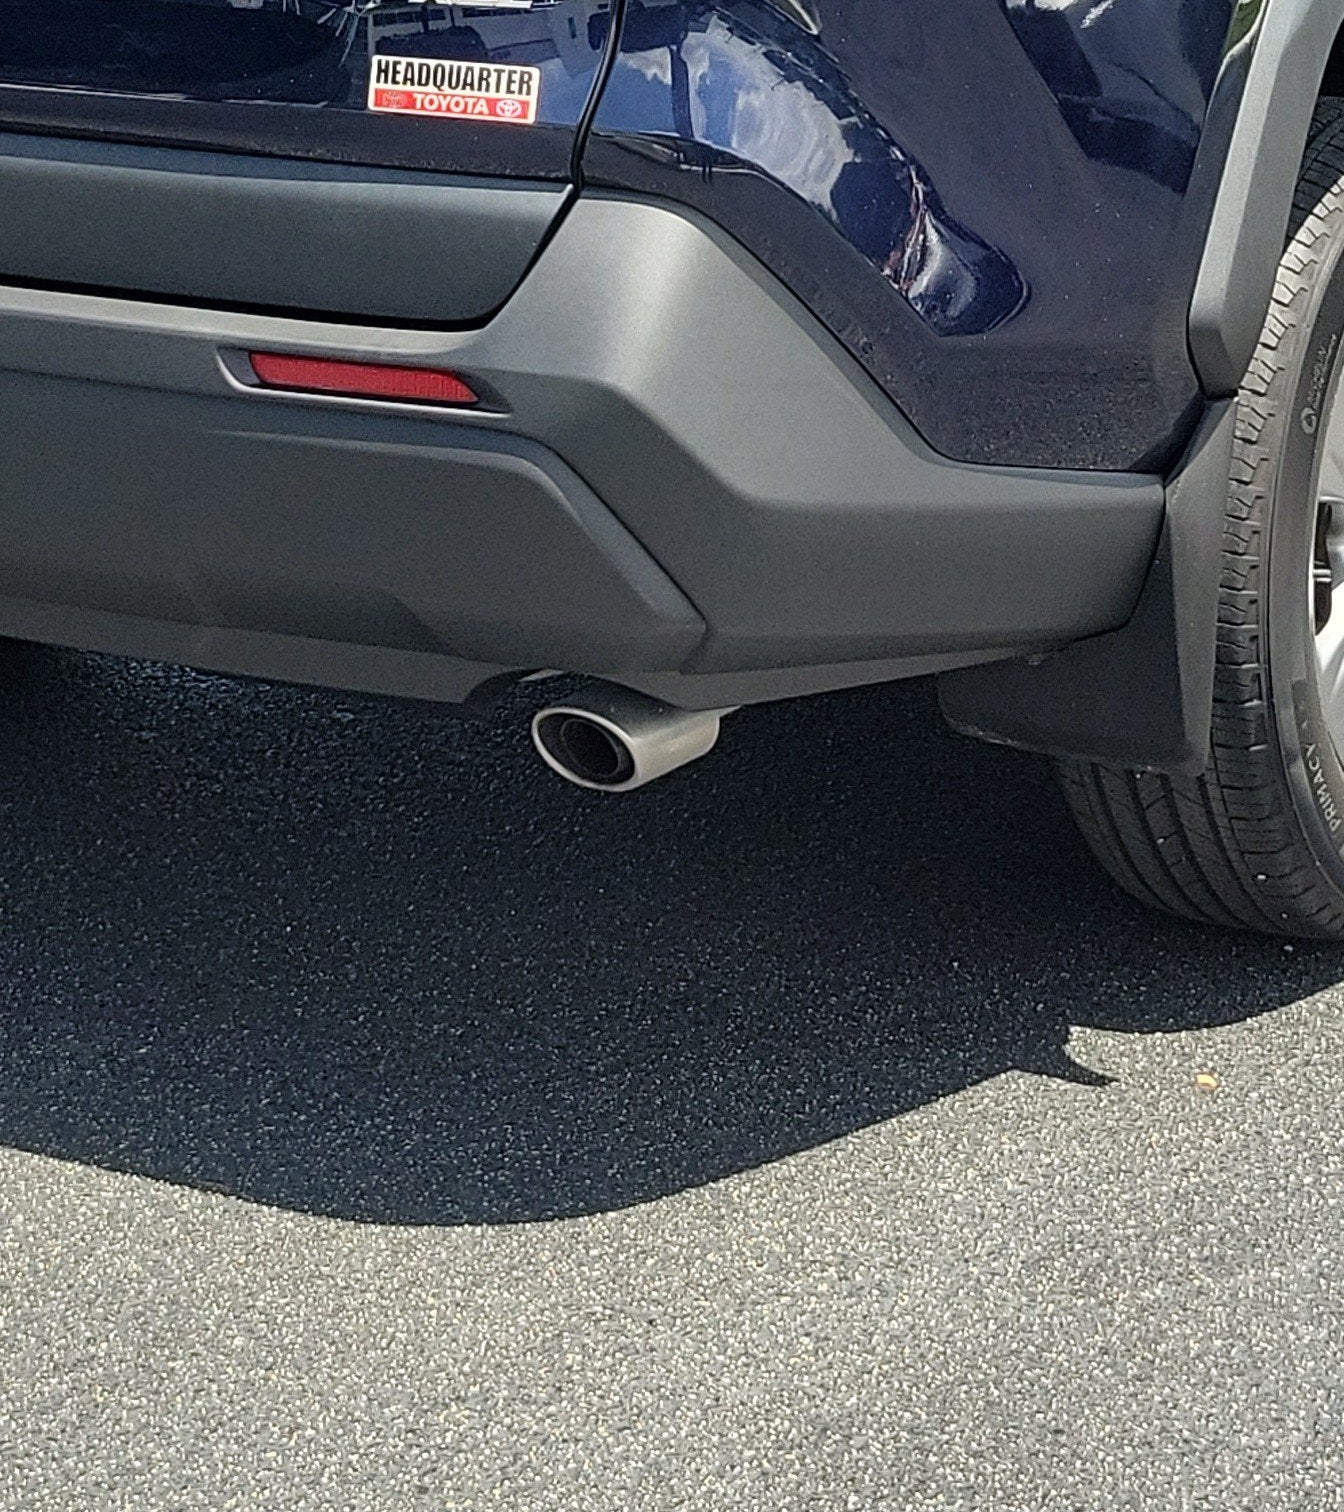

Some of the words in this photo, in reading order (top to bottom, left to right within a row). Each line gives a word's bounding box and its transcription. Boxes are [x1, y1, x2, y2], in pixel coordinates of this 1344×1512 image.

[375, 58, 533, 96] HEADQUARTER
[412, 92, 490, 115] TOYOTA
[1304, 740, 1343, 833] PRIMACY
